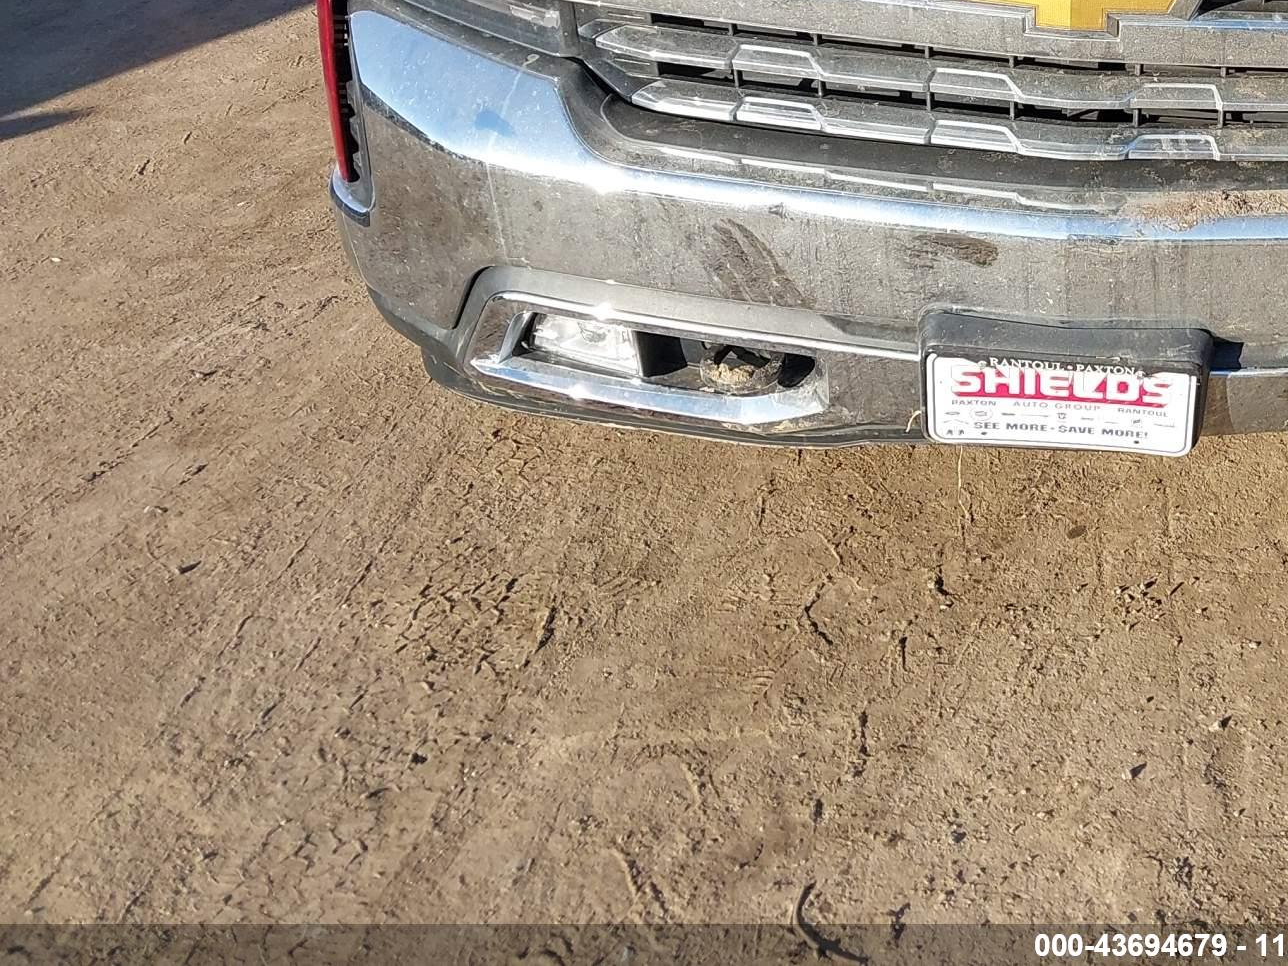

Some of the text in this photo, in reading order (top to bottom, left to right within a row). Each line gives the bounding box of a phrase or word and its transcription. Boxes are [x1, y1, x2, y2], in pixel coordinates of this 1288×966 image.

[989, 357, 1135, 376] RANTOUL PAXTON
[951, 363, 1172, 408] SHIELDS
[951, 399, 998, 407] PAXTON
[1013, 400, 1049, 409] AUTO
[1055, 402, 1101, 411] GROUP
[1117, 407, 1169, 418] RANTOUL
[973, 421, 1148, 439] SEE MORE SAVE MORE!
